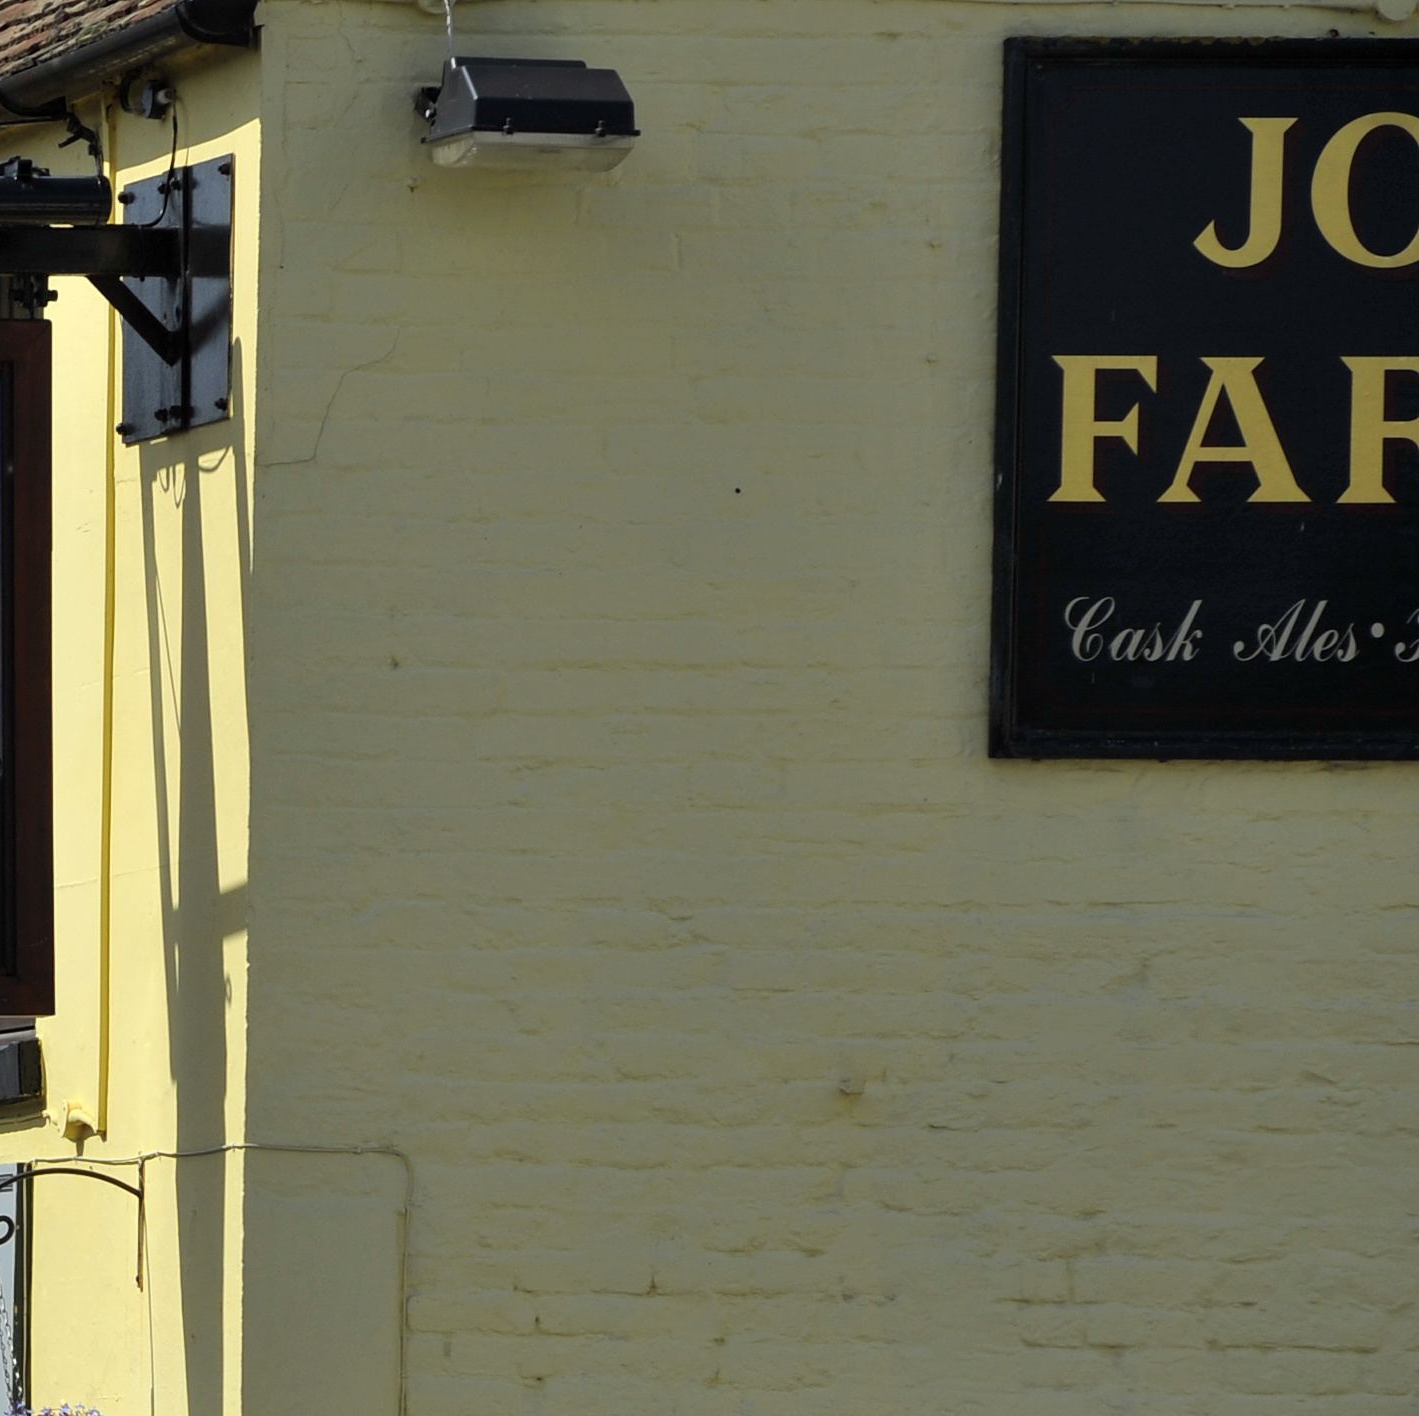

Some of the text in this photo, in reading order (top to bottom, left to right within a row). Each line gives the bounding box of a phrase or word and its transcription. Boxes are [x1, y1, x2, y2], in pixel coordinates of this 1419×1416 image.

[1193, 112, 1419, 268] JO
[1065, 596, 1203, 662] Cask
[1233, 598, 1360, 662] Ales
